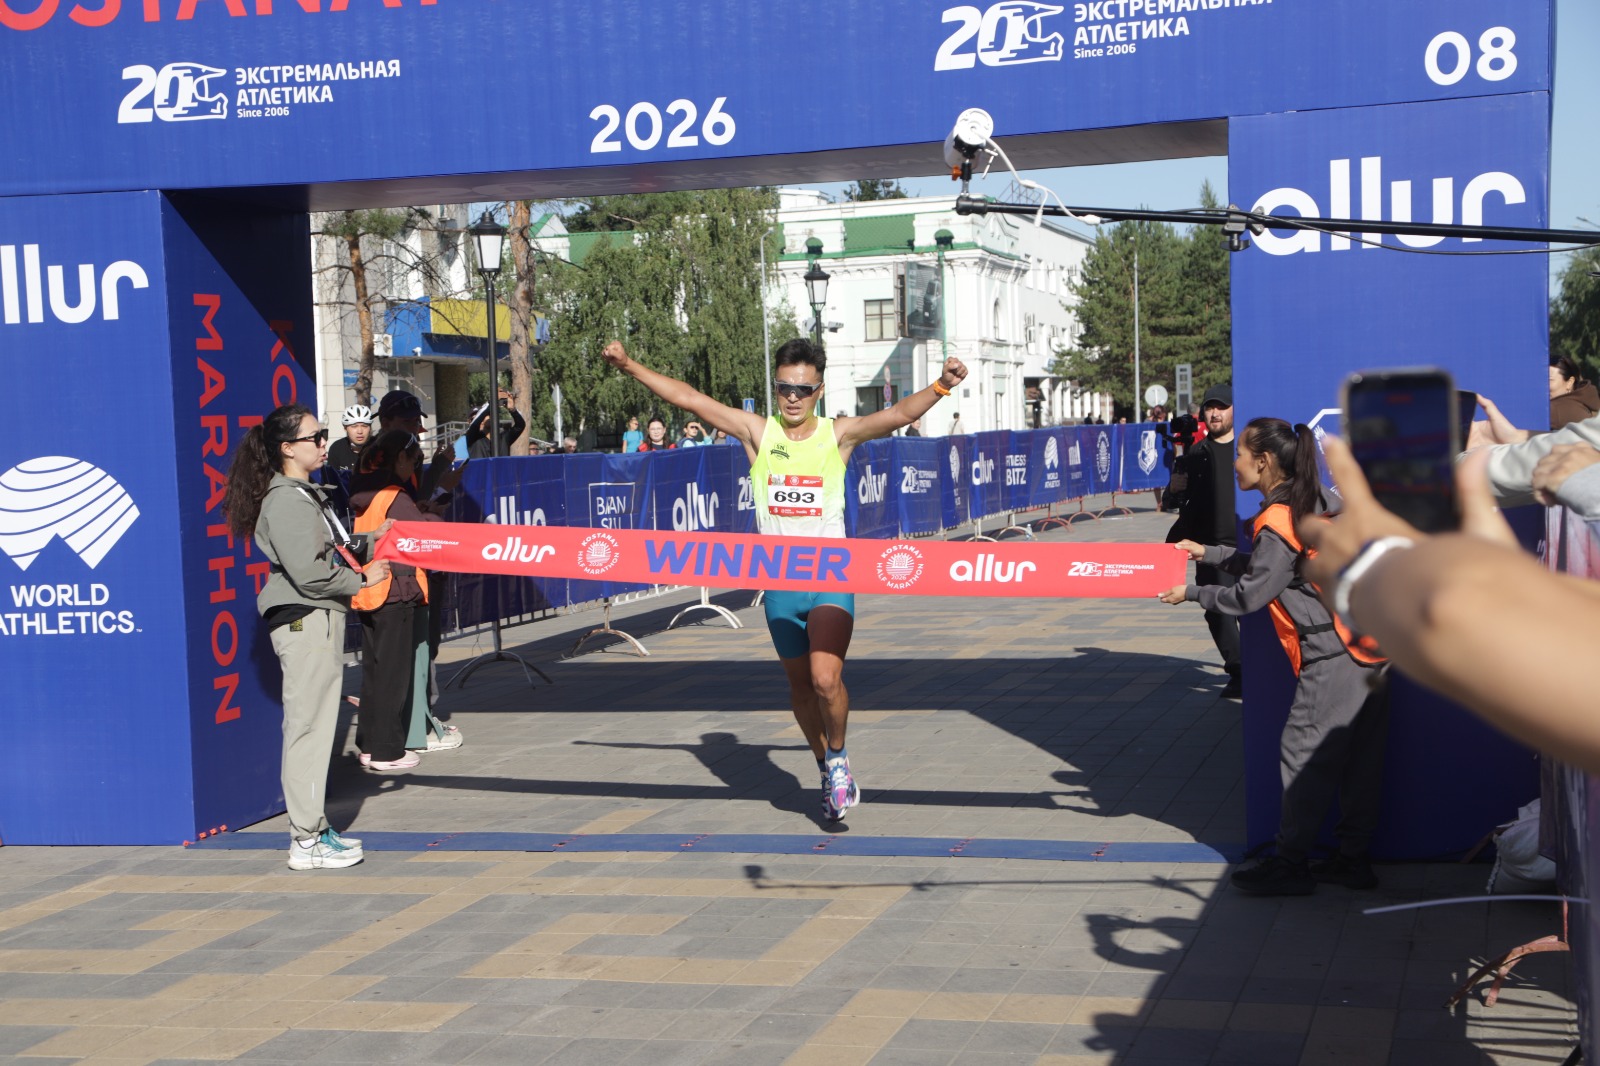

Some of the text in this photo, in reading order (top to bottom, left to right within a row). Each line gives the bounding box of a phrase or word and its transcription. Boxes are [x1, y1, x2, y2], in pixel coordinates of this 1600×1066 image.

[1074, 16, 1190, 46] АТЛЕТИКА
[1074, 43, 1137, 59] Since 2006
[1424, 26, 1518, 86] 08
[236, 59, 401, 86] ЭКСТРЕМАЛЬНАЯ
[236, 85, 334, 106] АТЛЕТИКА
[237, 106, 290, 118] Since 2006
[590, 96, 736, 154] 2026
[1250, 156, 1526, 256] allur
[0, 243, 149, 325] llur
[858, 464, 887, 505] allur
[1006, 467, 1027, 486] BITZ
[193, 293, 242, 725] MARATHON
[774, 490, 815, 504] 693
[481, 536, 556, 563] allur
[581, 532, 620, 548] KOSTANAY
[880, 544, 924, 559] KOSTANAY
[583, 552, 620, 575] MARATHON
[645, 539, 851, 582] WINNER
[949, 553, 1037, 583] allur
[876, 562, 925, 589] HALF MARATHON
[10, 583, 110, 608] WORLD
